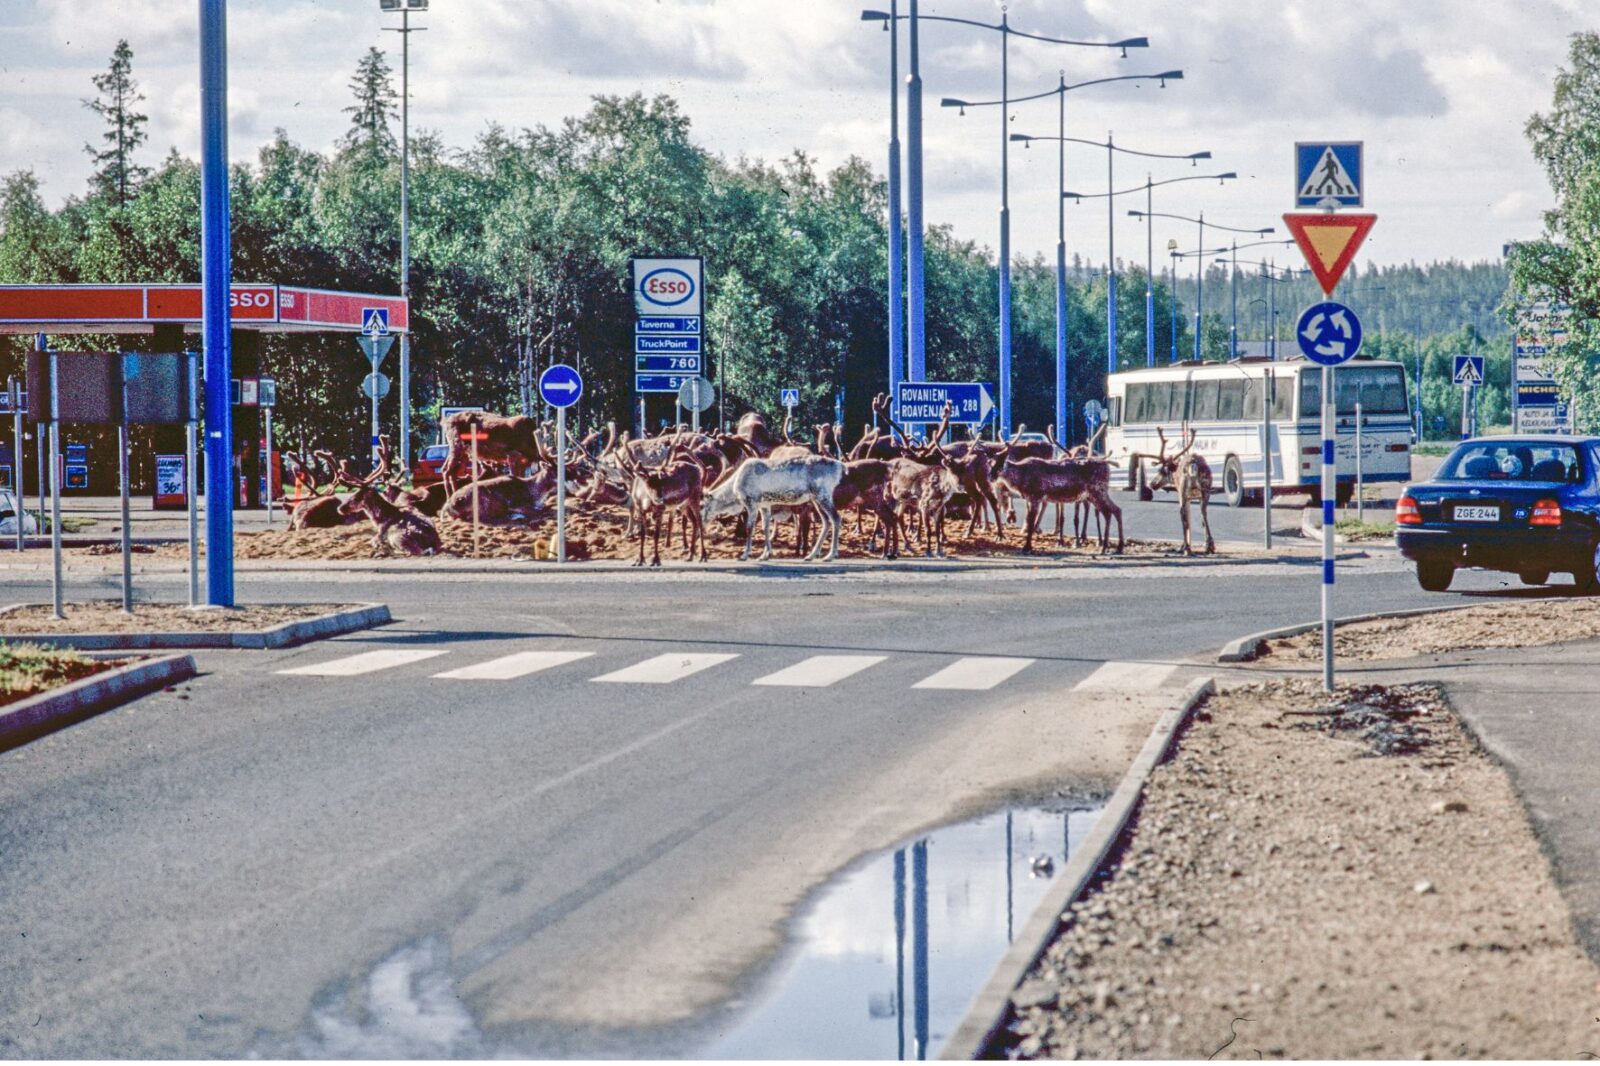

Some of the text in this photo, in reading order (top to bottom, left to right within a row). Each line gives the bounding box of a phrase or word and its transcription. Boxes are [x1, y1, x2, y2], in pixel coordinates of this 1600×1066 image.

[230, 292, 270, 307] SSO
[640, 320, 675, 329] Taverna
[640, 339, 688, 348] TruckPoint
[901, 388, 948, 402] ROVANIEMI
[962, 399, 978, 412] 288
[1556, 405, 1566, 417] P
[1456, 507, 1498, 519] ZGE-244
